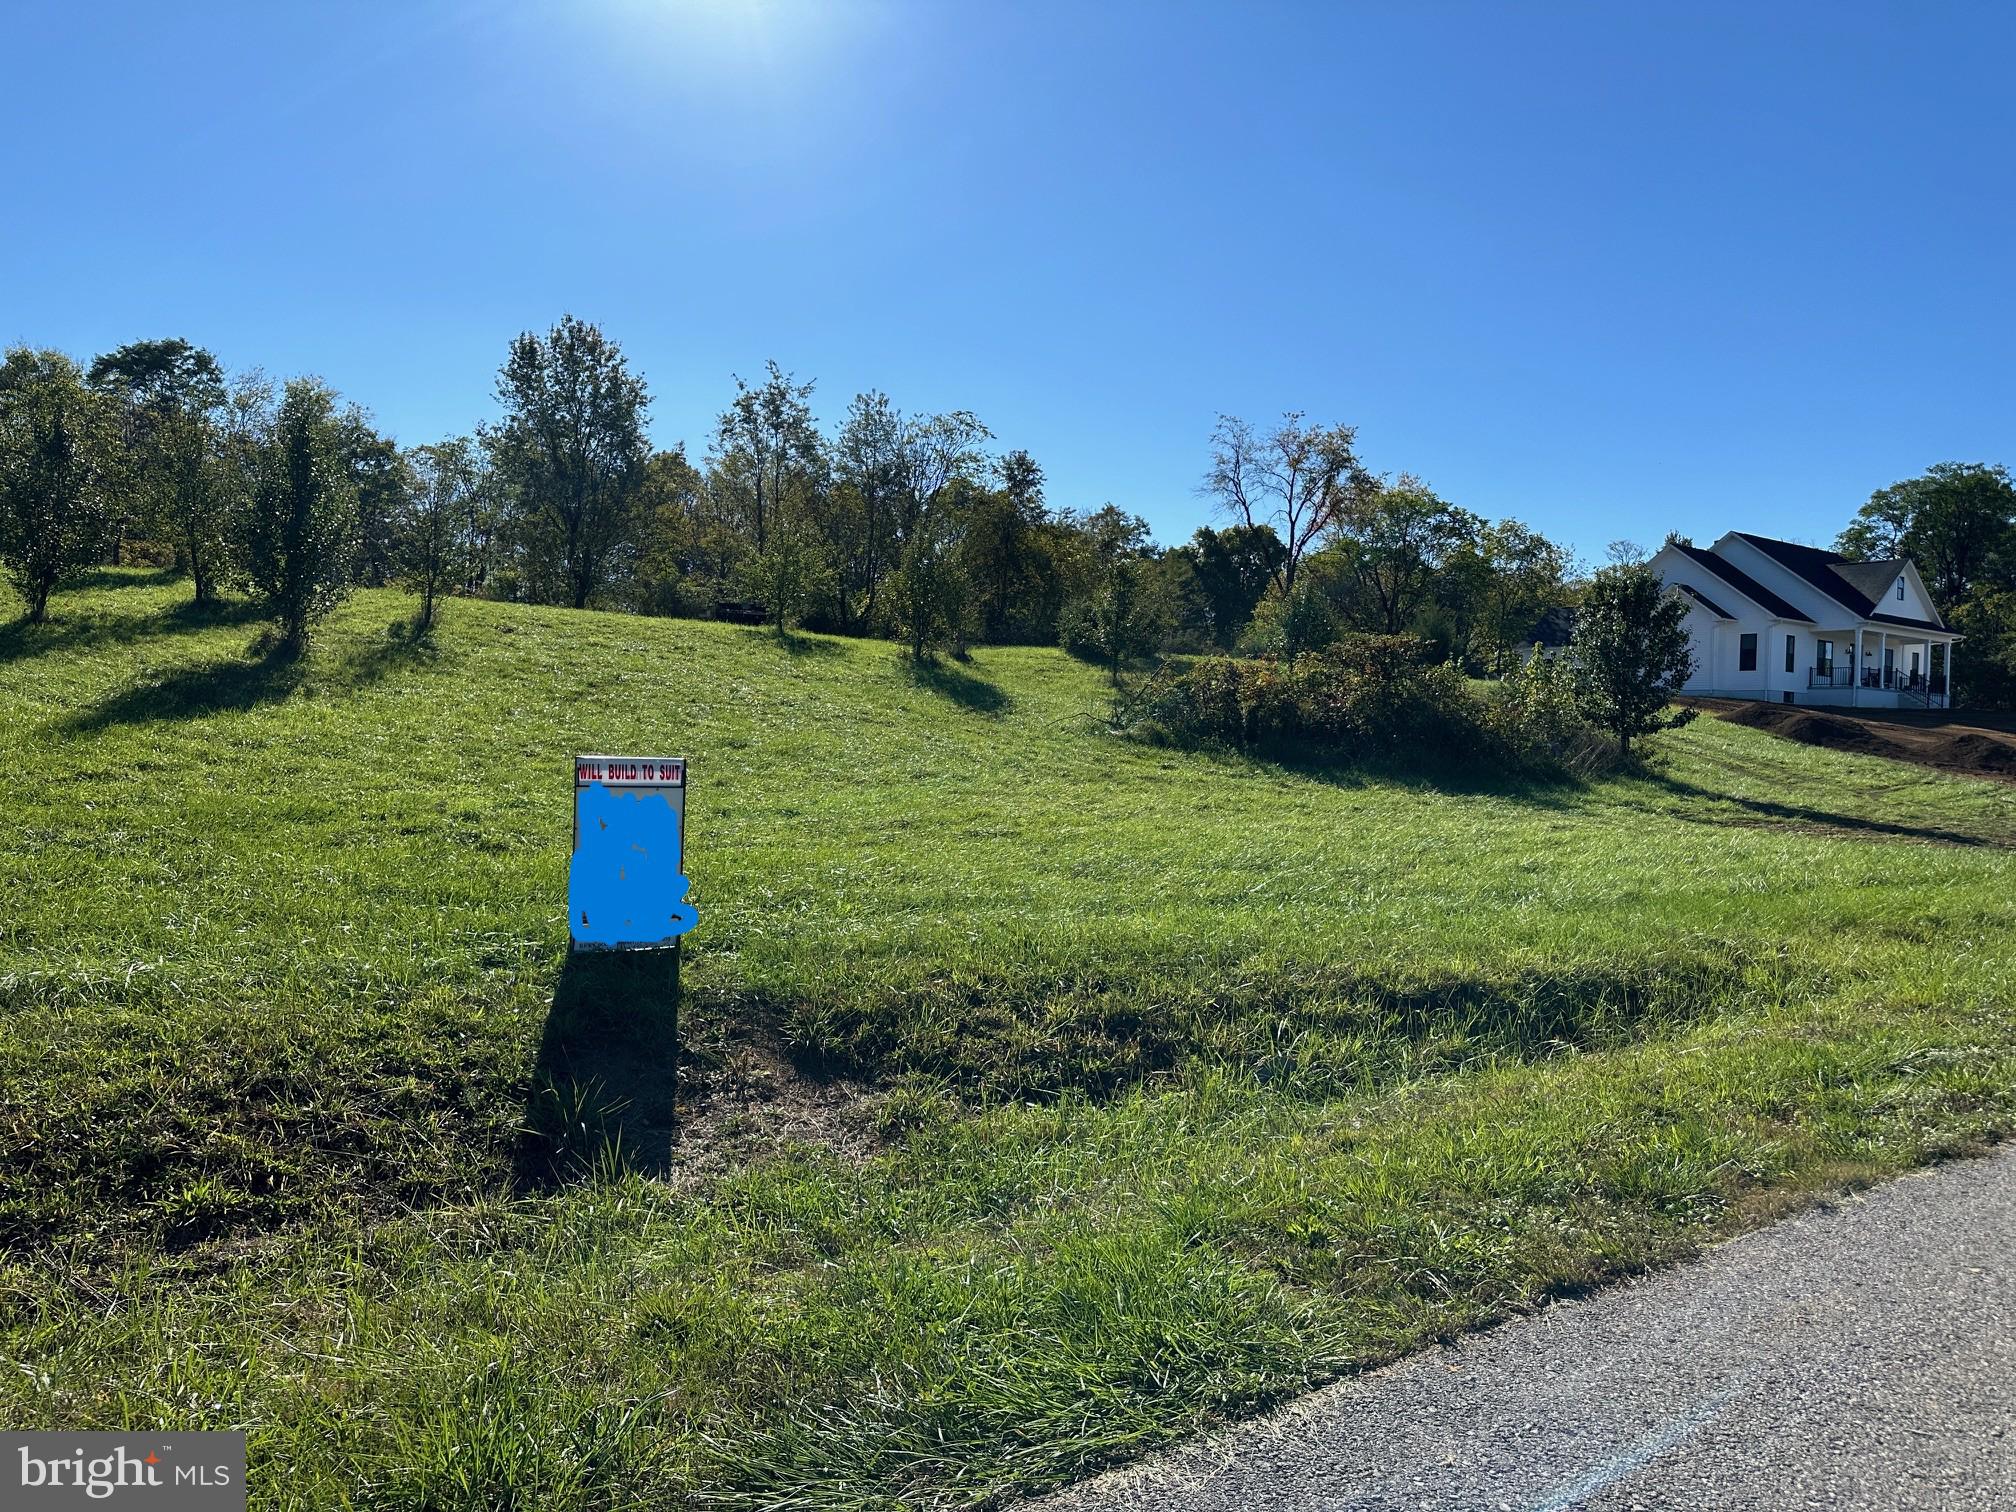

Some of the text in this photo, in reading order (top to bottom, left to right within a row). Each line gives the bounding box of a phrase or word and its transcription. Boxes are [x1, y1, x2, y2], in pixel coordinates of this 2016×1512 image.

[579, 763, 681, 780] WILL BUILD TO SUIT
